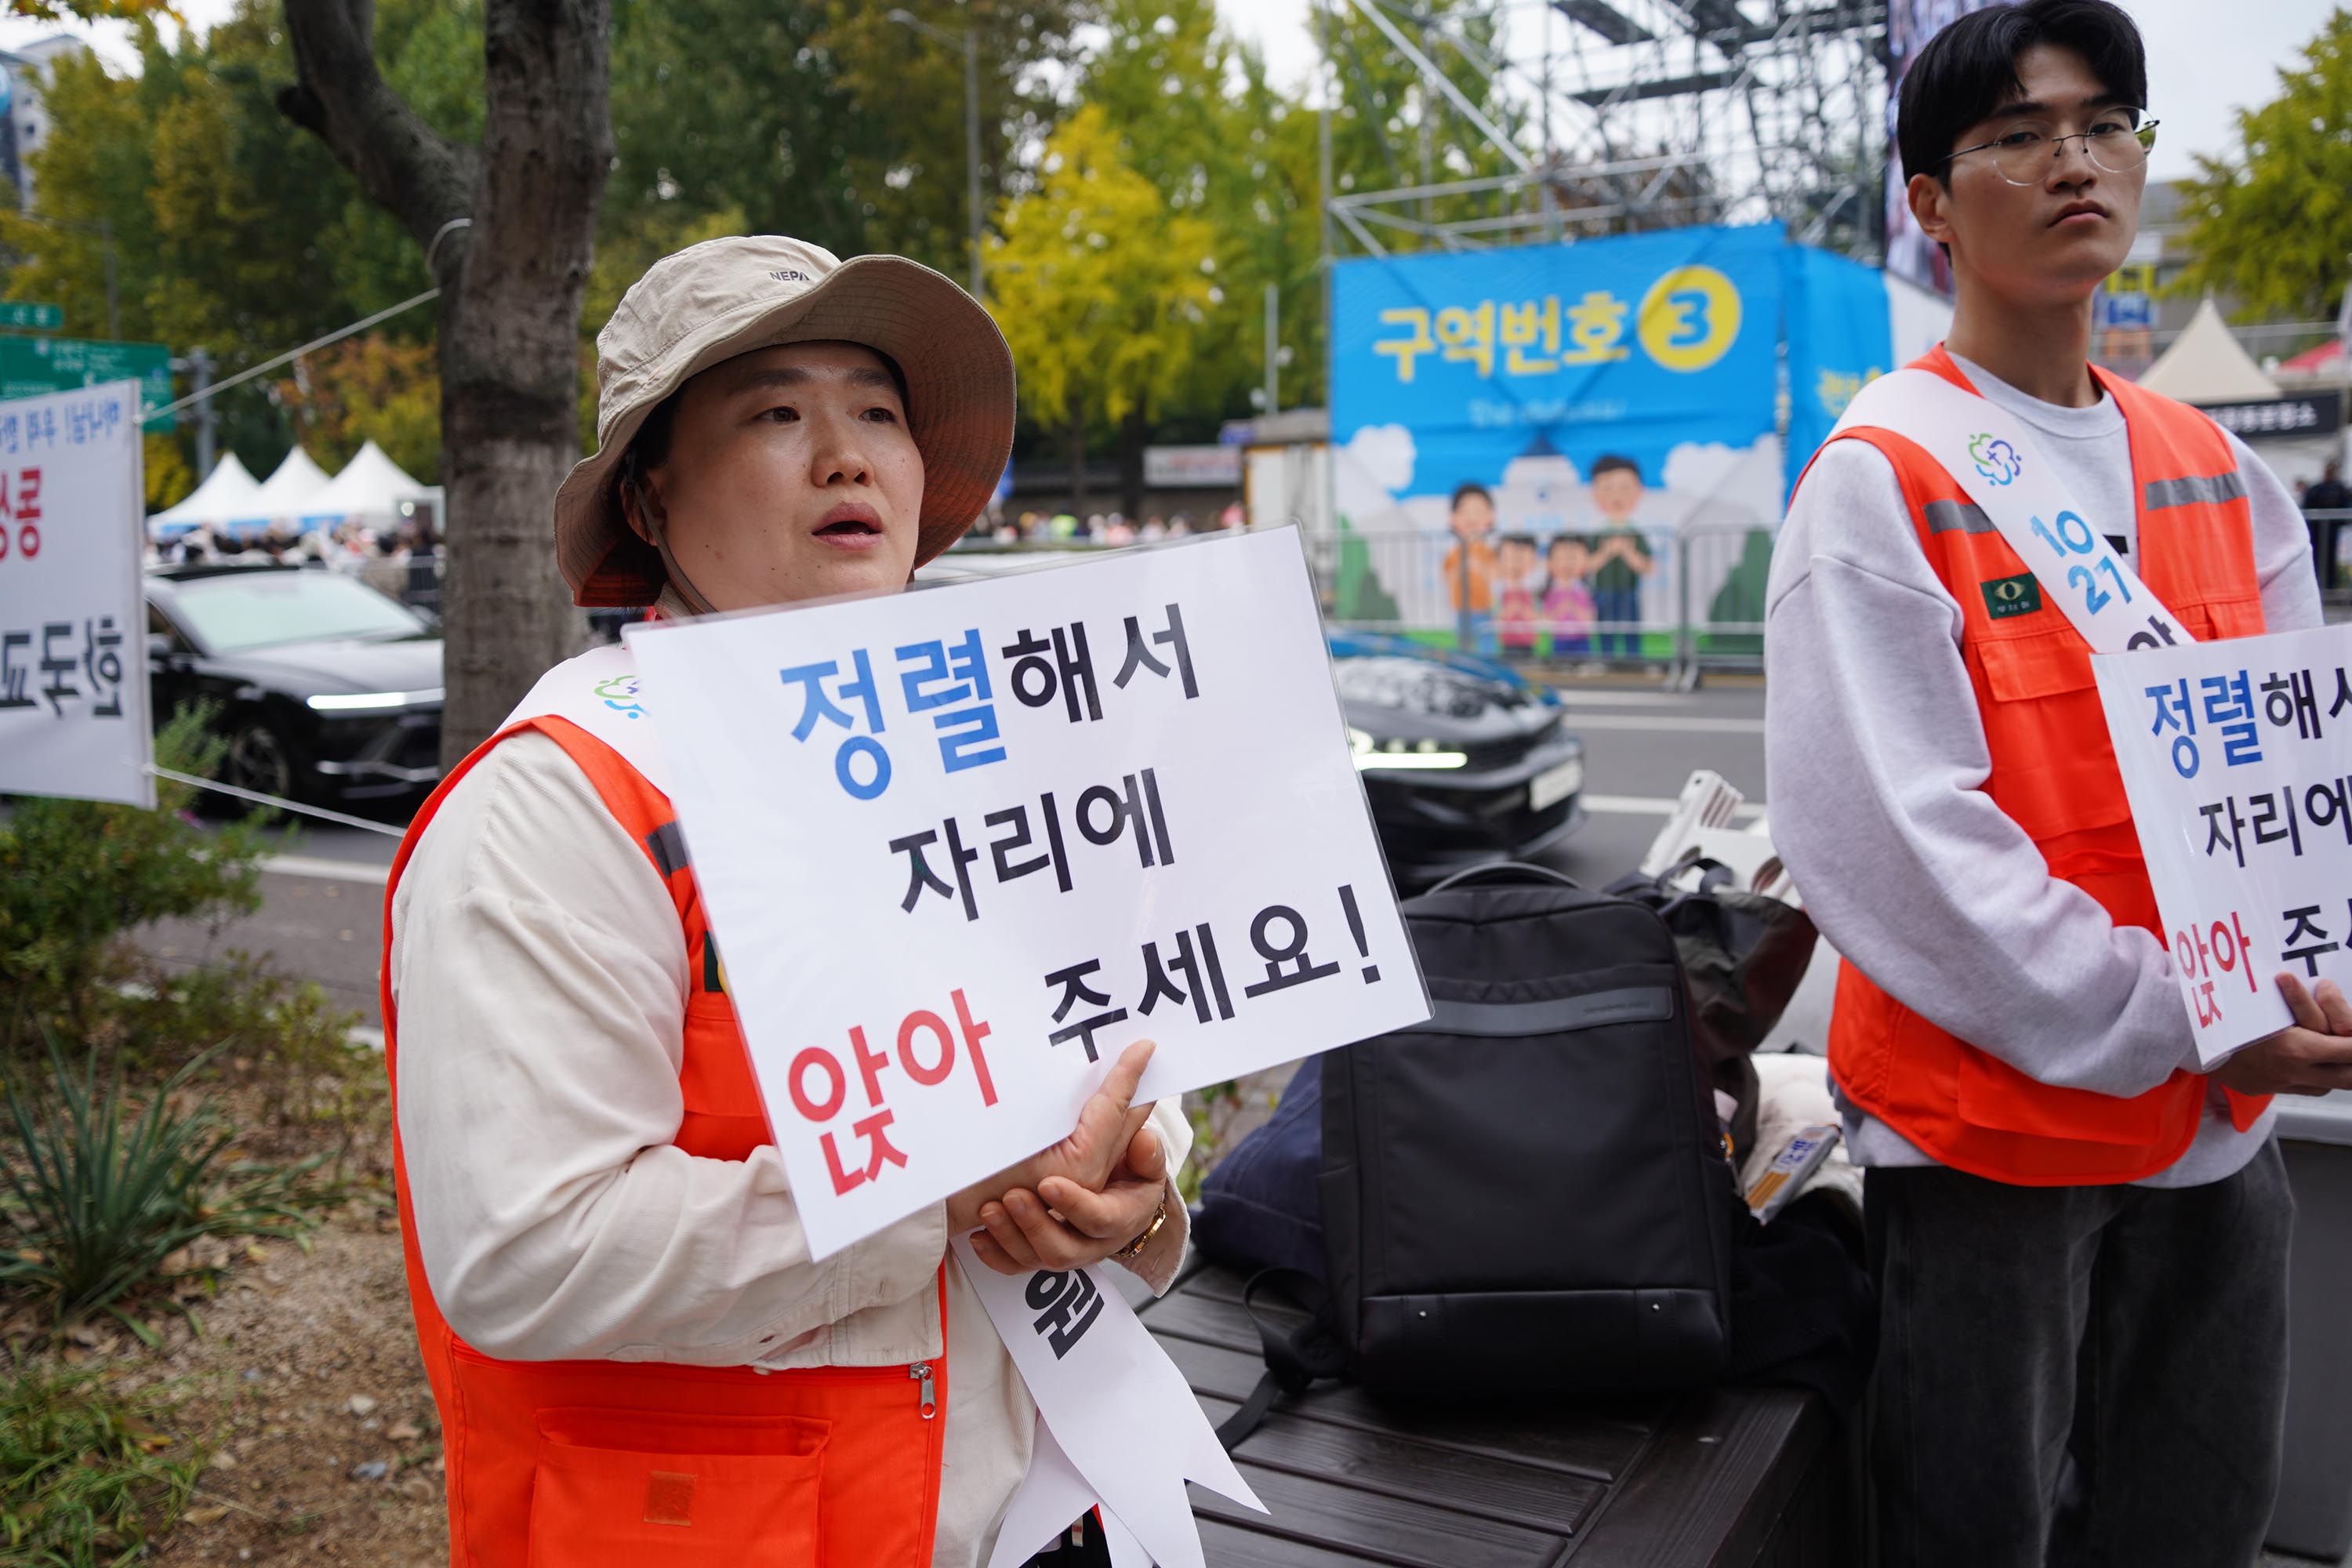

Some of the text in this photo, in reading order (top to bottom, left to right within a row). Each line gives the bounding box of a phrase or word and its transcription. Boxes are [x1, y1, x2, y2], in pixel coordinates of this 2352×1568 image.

[769, 270, 810, 281] NEPA
[1374, 287, 1713, 383] 구역번호 3
[2030, 510, 2094, 558] 10
[2067, 555, 2132, 615] 27
[779, 603, 1200, 800] 정렬해서
[888, 768, 1175, 922] 자리에
[2176, 897, 2352, 1029] 앉아 주
[788, 884, 1381, 1198] 앉아 주세요!
[1025, 1269, 1105, 1360] 원
